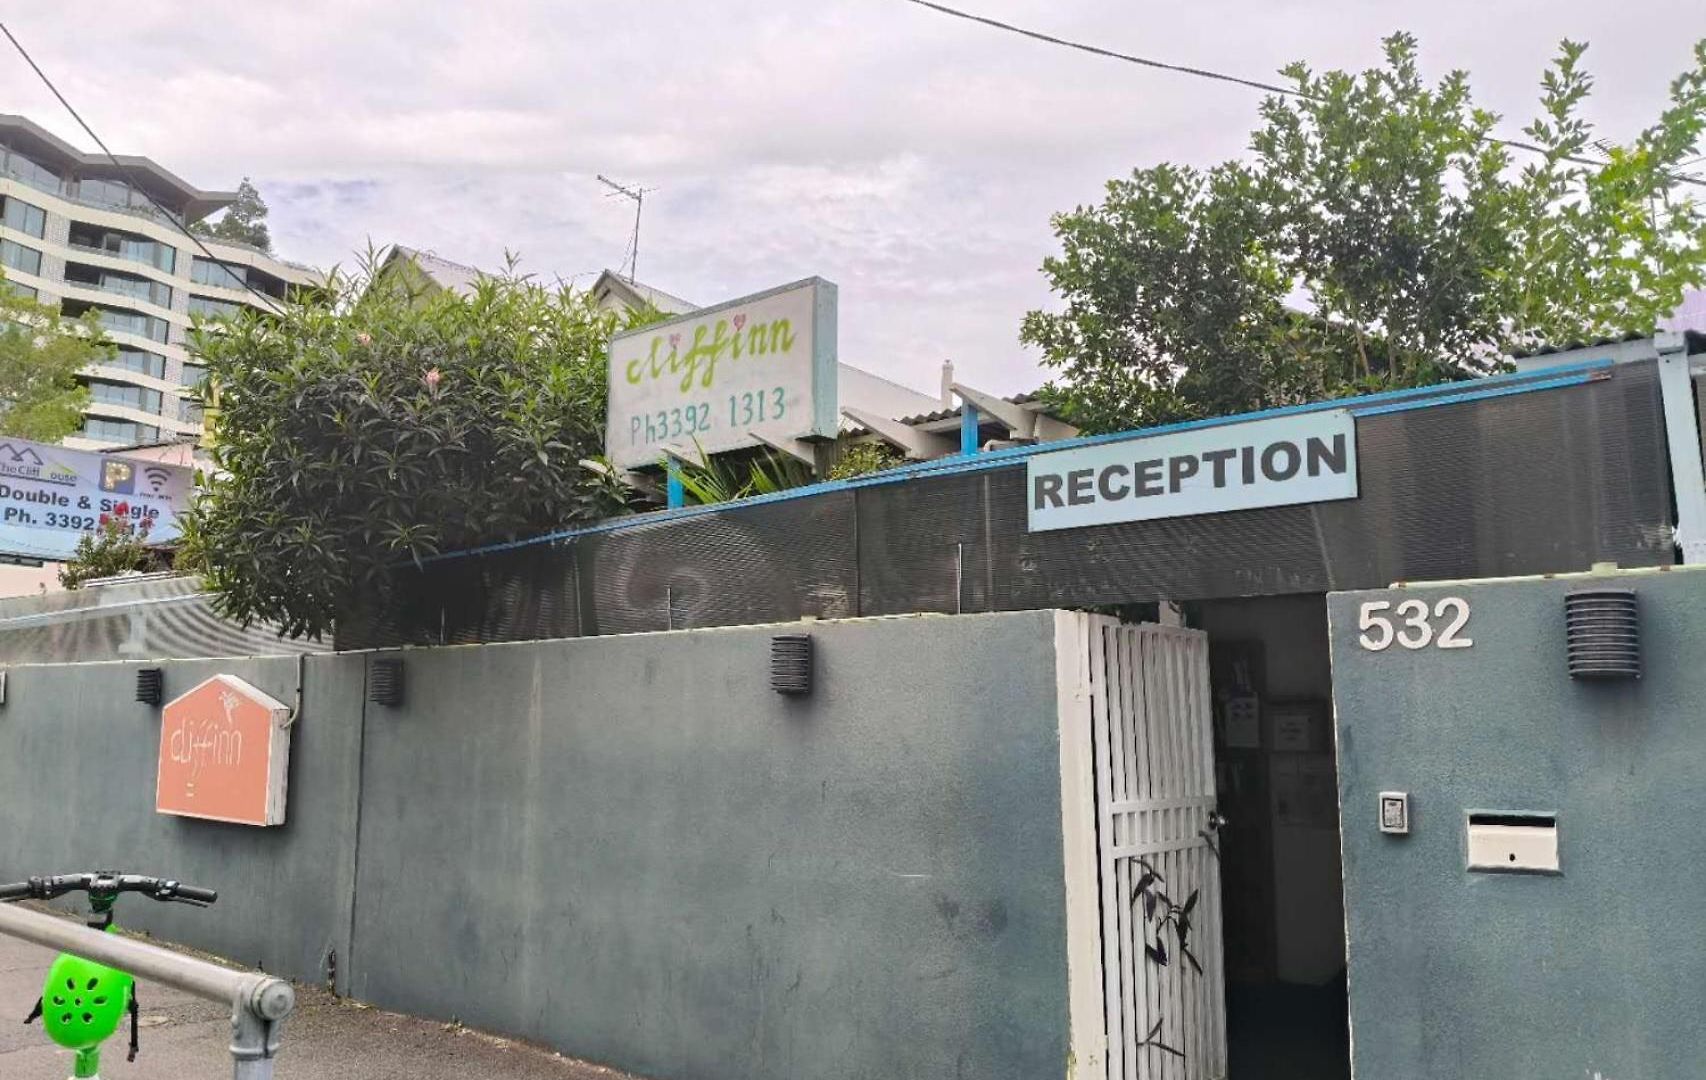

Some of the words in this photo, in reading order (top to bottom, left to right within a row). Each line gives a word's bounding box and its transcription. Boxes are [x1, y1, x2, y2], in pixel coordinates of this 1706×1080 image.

[730, 387, 785, 428] 1313
[1034, 433, 1348, 511] RECEPTION
[0, 485, 70, 507] Double
[78, 495, 92, 510] &
[4, 507, 37, 525] Ph.
[45, 512, 95, 531] 3392
[1359, 597, 1473, 650] 532
